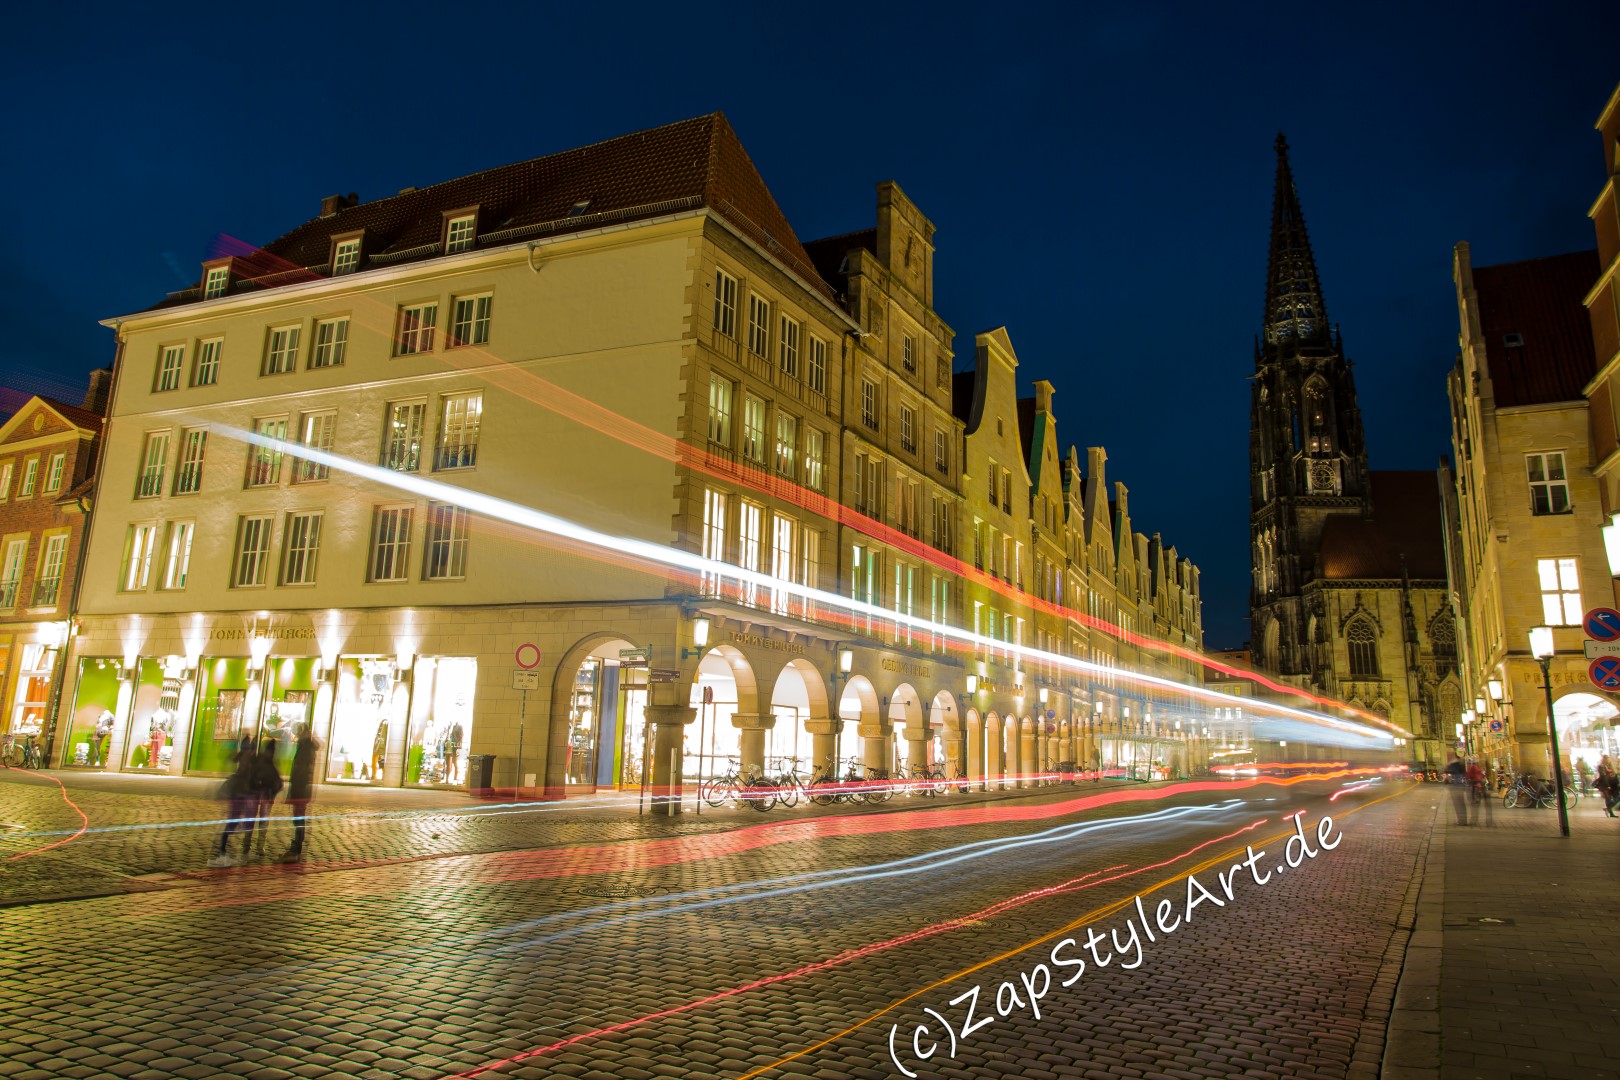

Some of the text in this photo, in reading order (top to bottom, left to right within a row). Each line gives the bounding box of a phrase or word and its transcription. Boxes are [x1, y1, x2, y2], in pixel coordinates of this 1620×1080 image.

[729, 631, 806, 654] TOMMY HILFIGER
[1523, 672, 1589, 684] PEZHO
